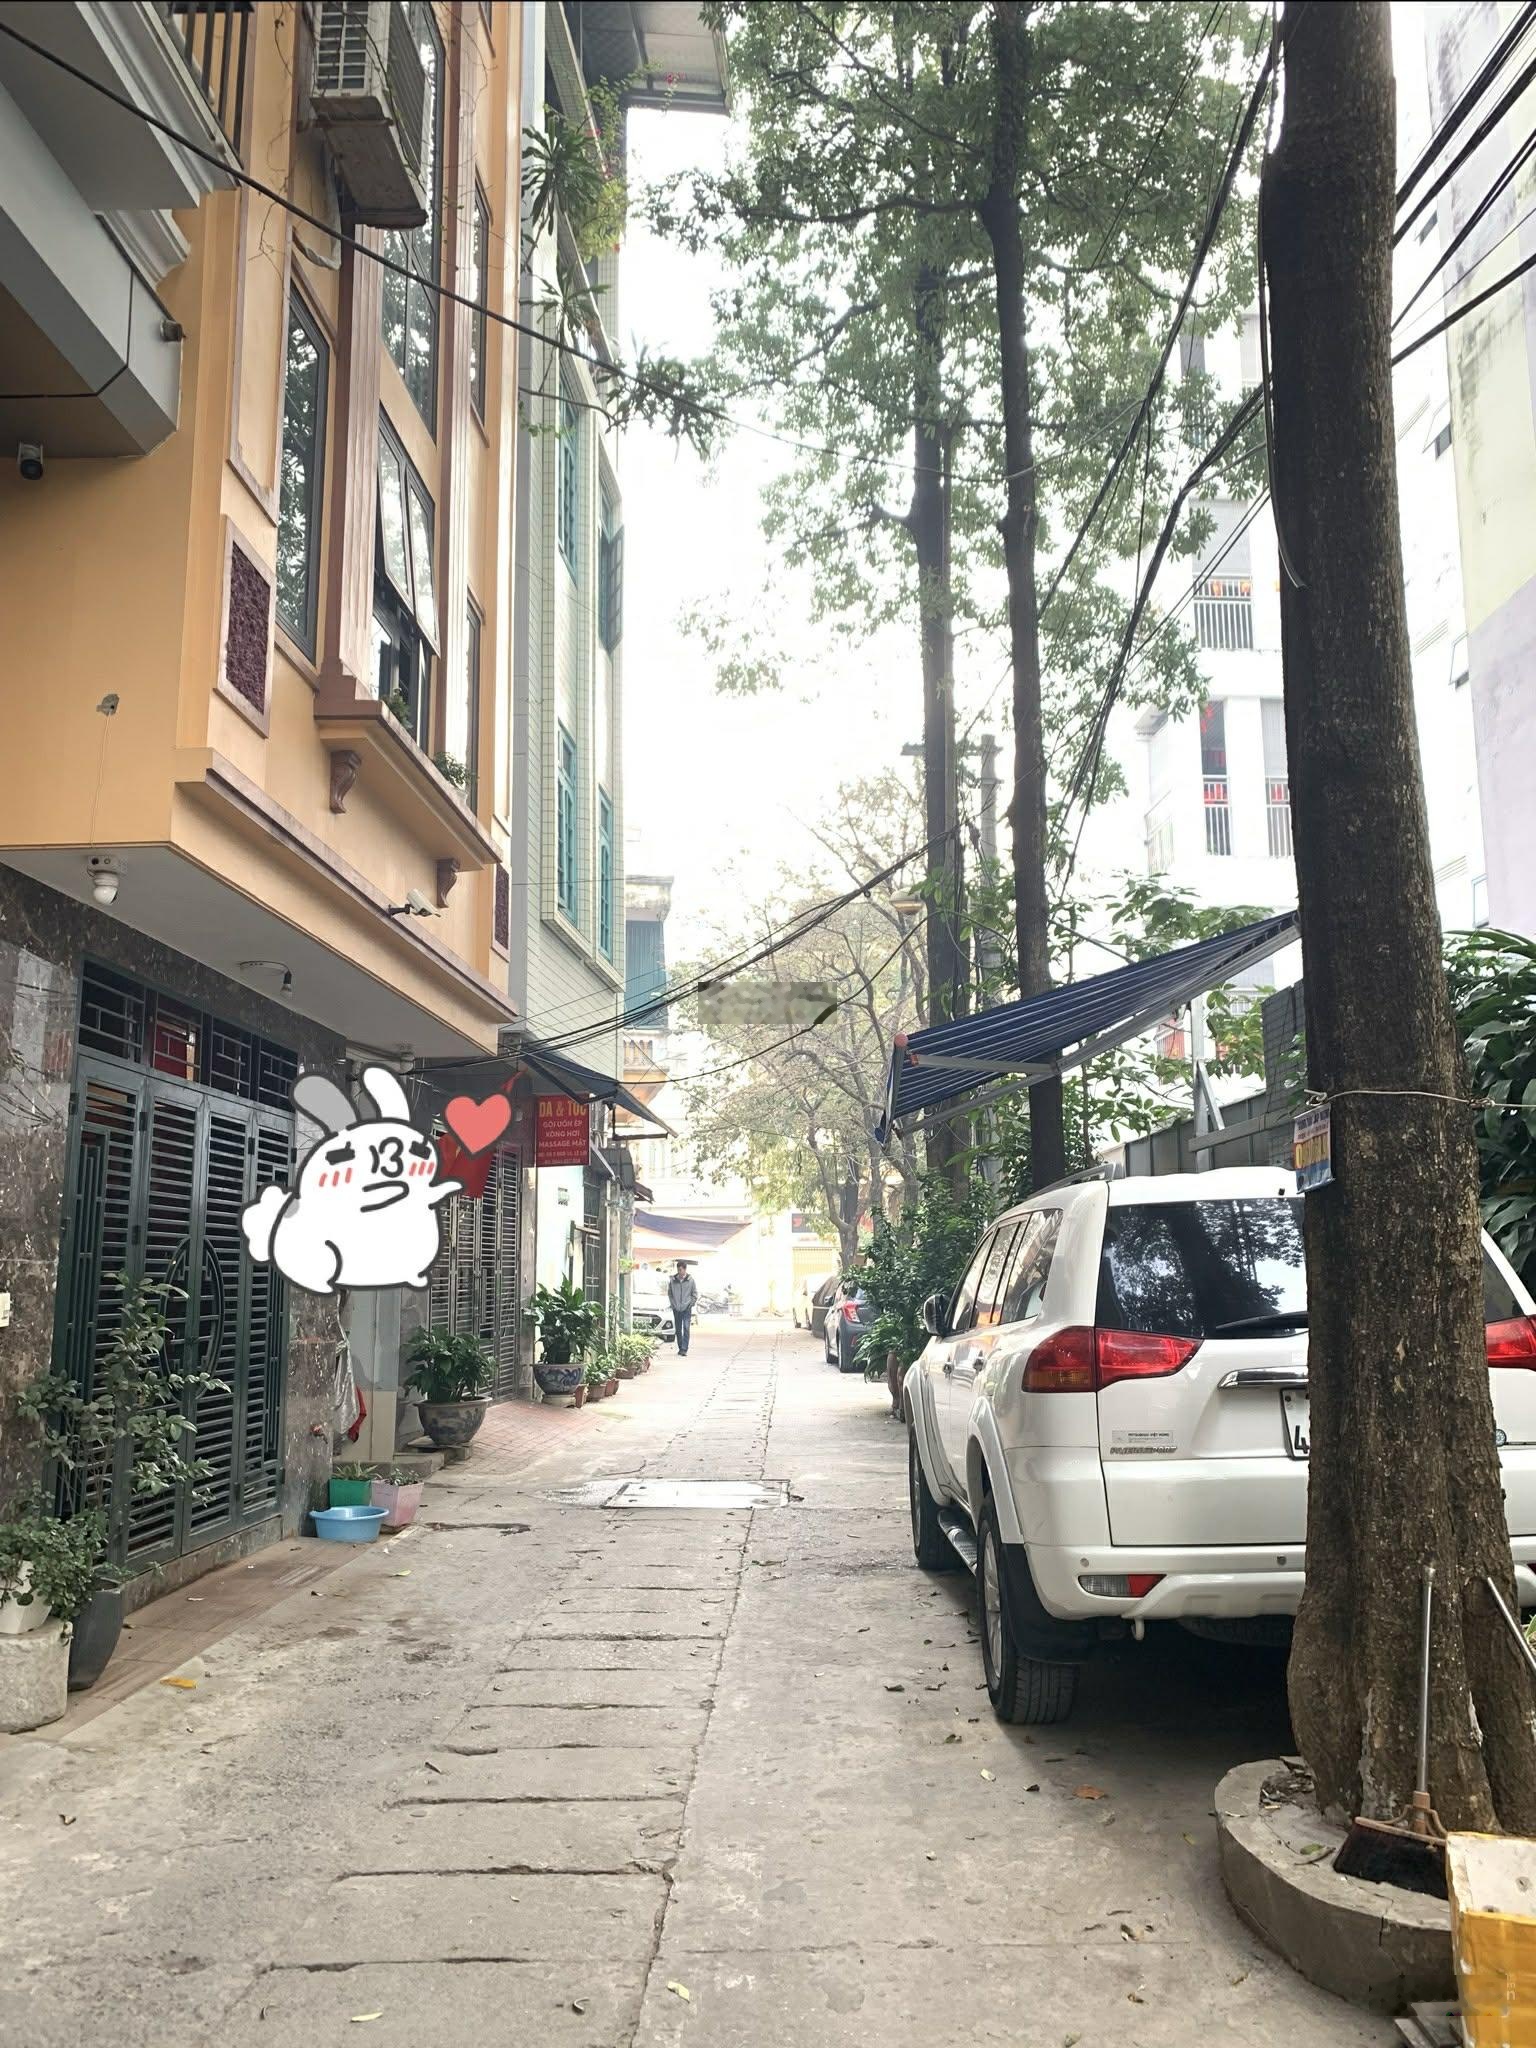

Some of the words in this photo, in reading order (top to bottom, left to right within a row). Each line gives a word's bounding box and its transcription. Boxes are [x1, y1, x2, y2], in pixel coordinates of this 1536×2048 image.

[539, 1101, 553, 1117] DA
[556, 1101, 564, 1117] &
[538, 1140, 571, 1148] MASSAGE
